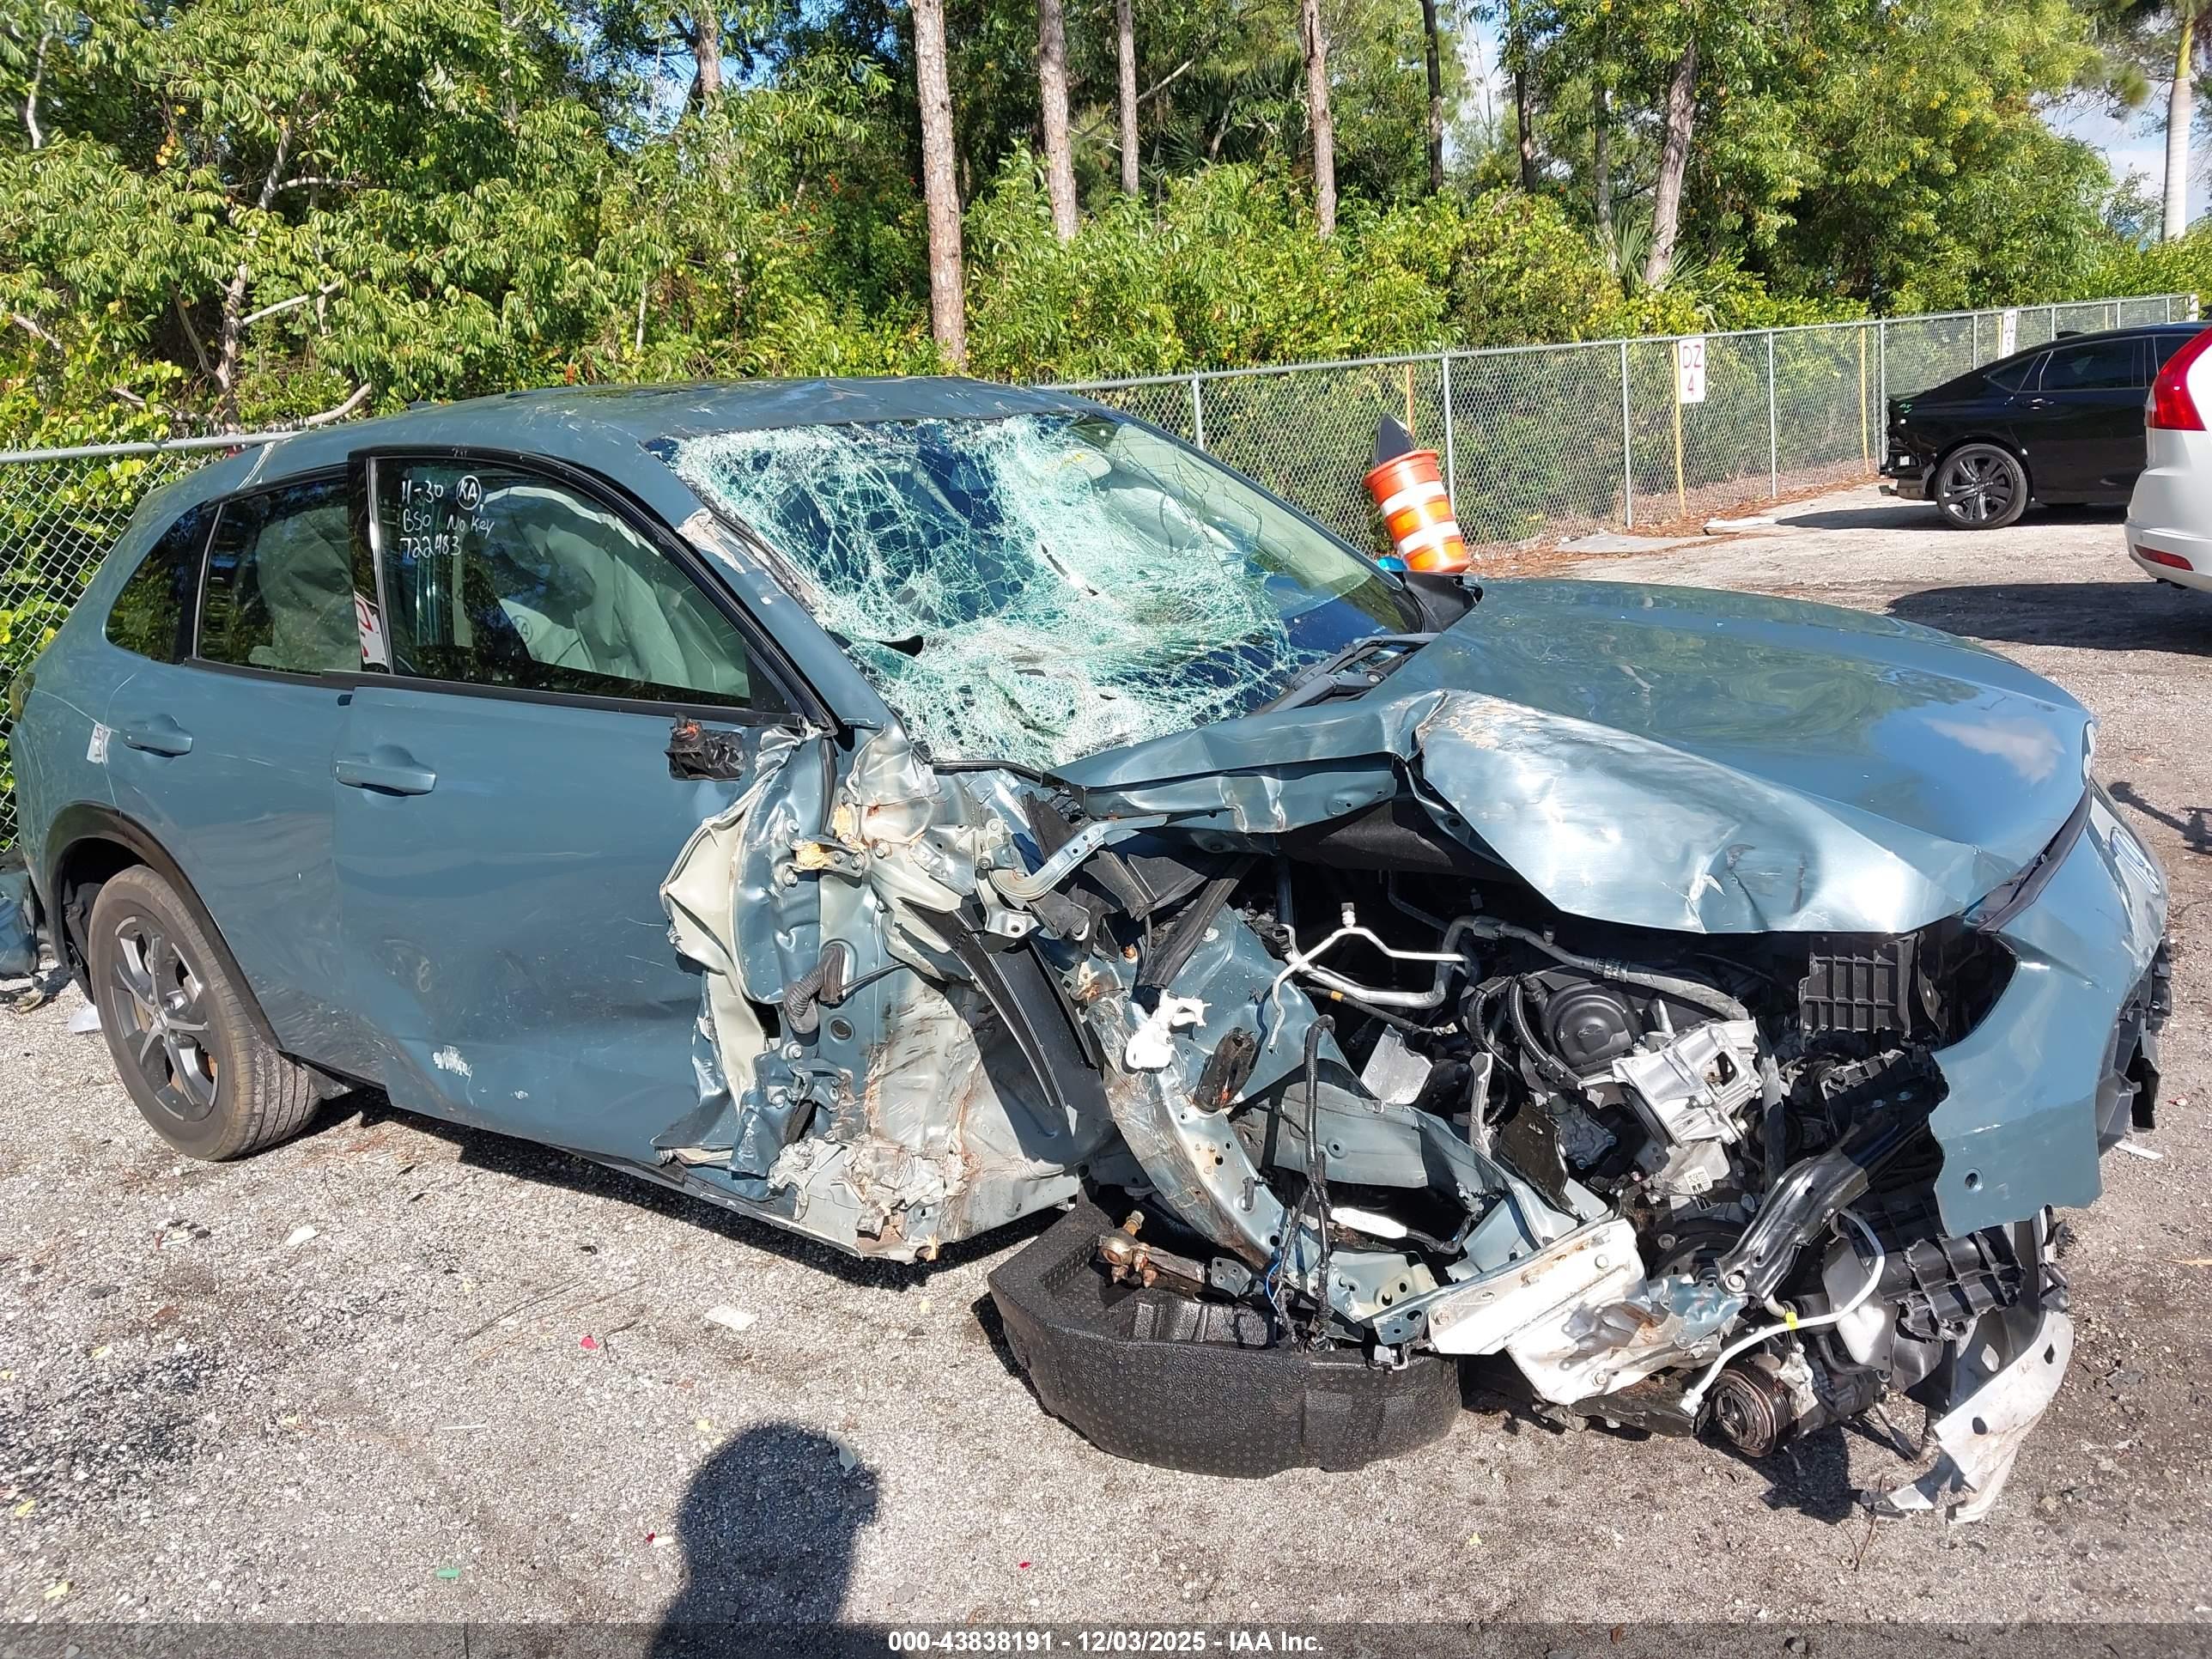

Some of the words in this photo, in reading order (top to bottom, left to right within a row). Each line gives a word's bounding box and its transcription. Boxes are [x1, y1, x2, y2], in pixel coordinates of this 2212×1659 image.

[1687, 372, 1695, 396] 4
[401, 479, 444, 505] 11-30
[457, 477, 479, 503] KA
[447, 514, 466, 532] No
[471, 514, 495, 539] Key
[399, 532, 461, 559] 722483
